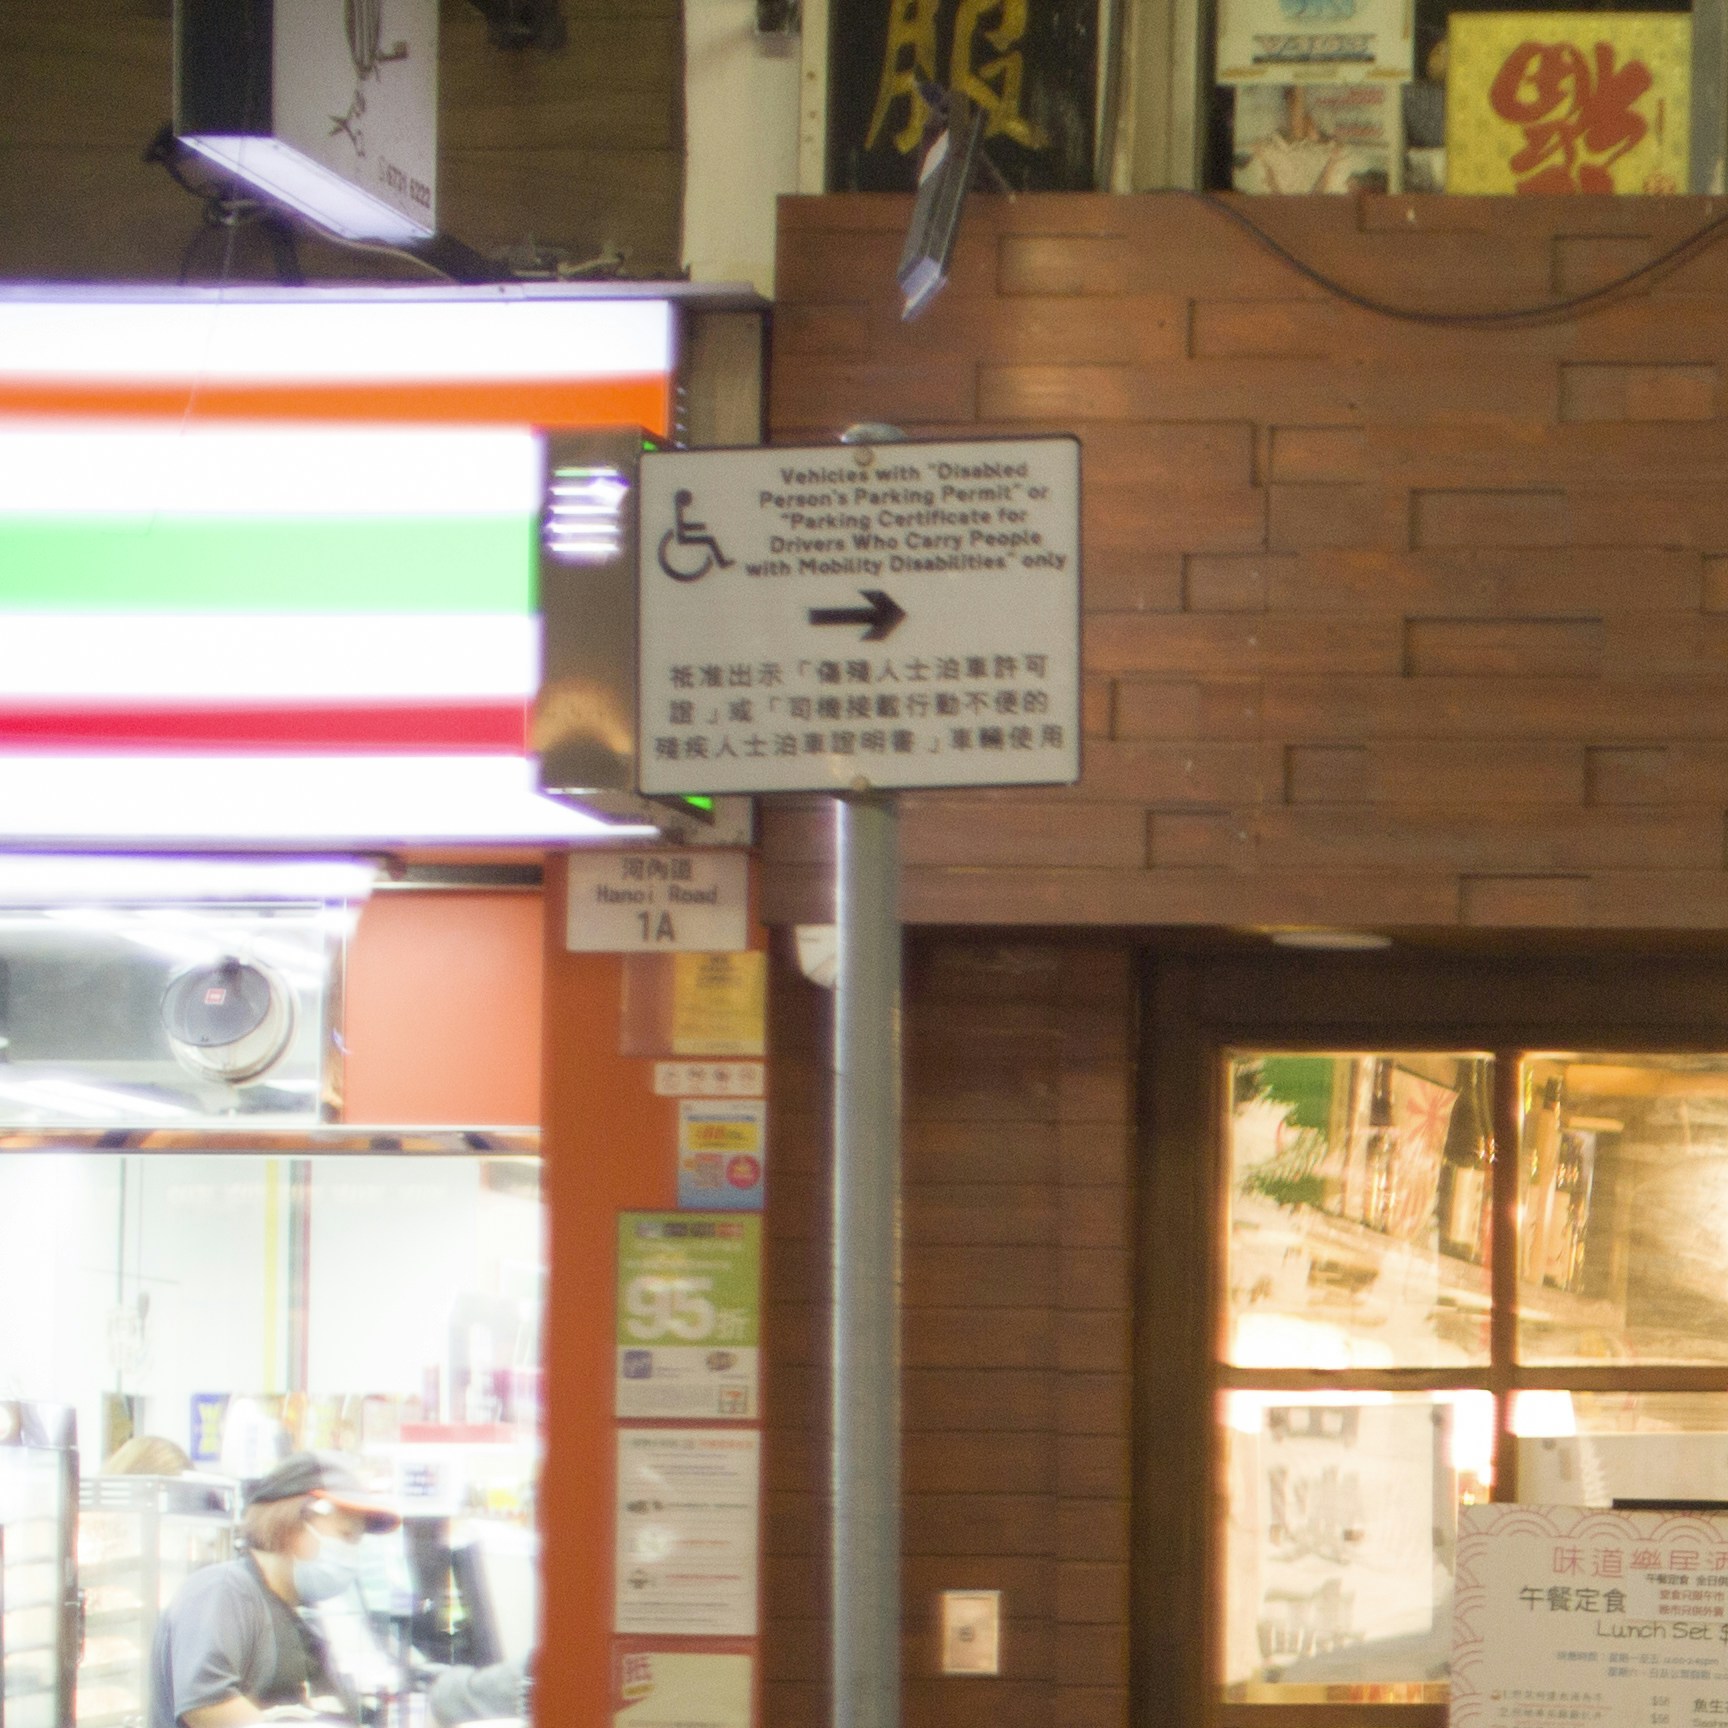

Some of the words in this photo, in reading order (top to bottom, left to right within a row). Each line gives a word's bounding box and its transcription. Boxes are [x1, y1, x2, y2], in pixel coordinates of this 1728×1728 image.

[780, 465, 871, 486] Vehicles
[876, 463, 922, 482] with
[854, 487, 935, 507] Parking
[1028, 486, 1049, 501] or
[878, 507, 994, 527] Certificate
[999, 506, 1028, 524] for
[770, 535, 847, 554] Drivers
[853, 532, 899, 552] Who
[905, 532, 963, 552] Carry
[970, 530, 1042, 550] People
[745, 559, 791, 578] with
[797, 555, 882, 577] Mobility
[1022, 551, 1066, 571] only
[667, 884, 717, 904] Road
[636, 910, 676, 943] 1A
[1518, 1585, 1628, 1614] 午餐定食
[1596, 1621, 1667, 1639] Lunch
[1672, 1622, 1712, 1642] Set
